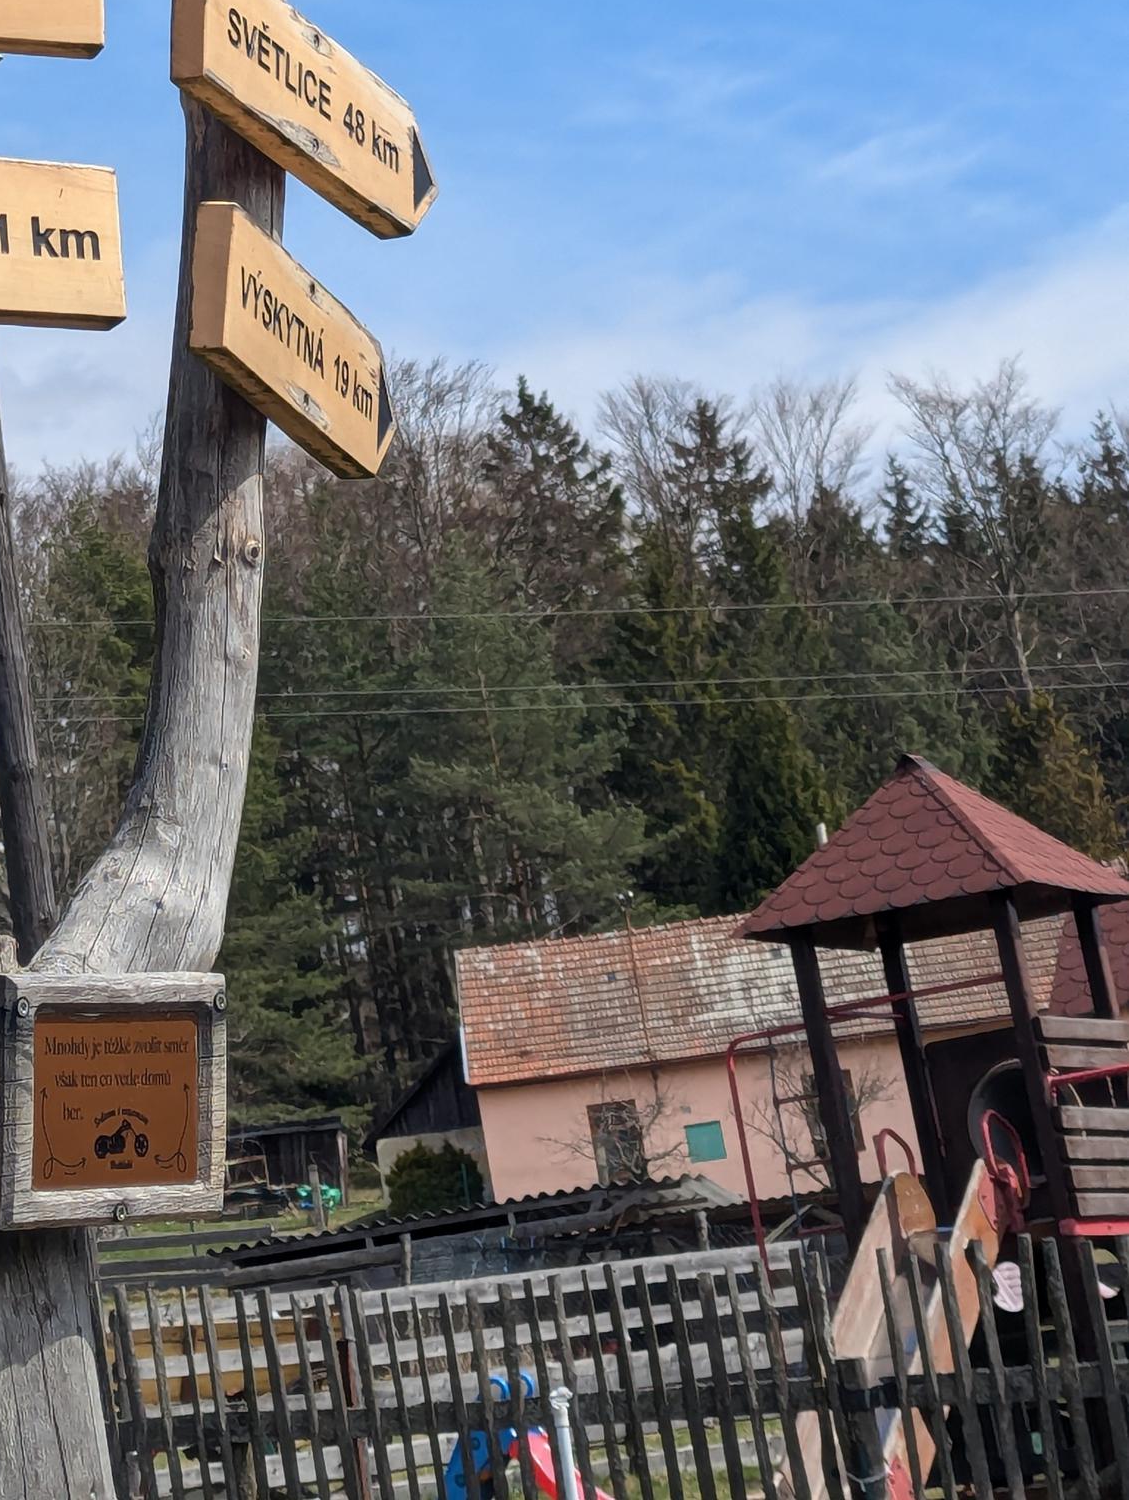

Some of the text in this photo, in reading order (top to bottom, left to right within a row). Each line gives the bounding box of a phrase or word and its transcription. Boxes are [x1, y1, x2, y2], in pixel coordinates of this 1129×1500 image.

[227, 7, 399, 173] SVĚTLICE 48 km
[32, 217, 100, 260] km
[241, 266, 373, 422] VÝSKYTNÁ 19 km
[45, 1037, 88, 1060] Mnohdy
[91, 1038, 101, 1059] je
